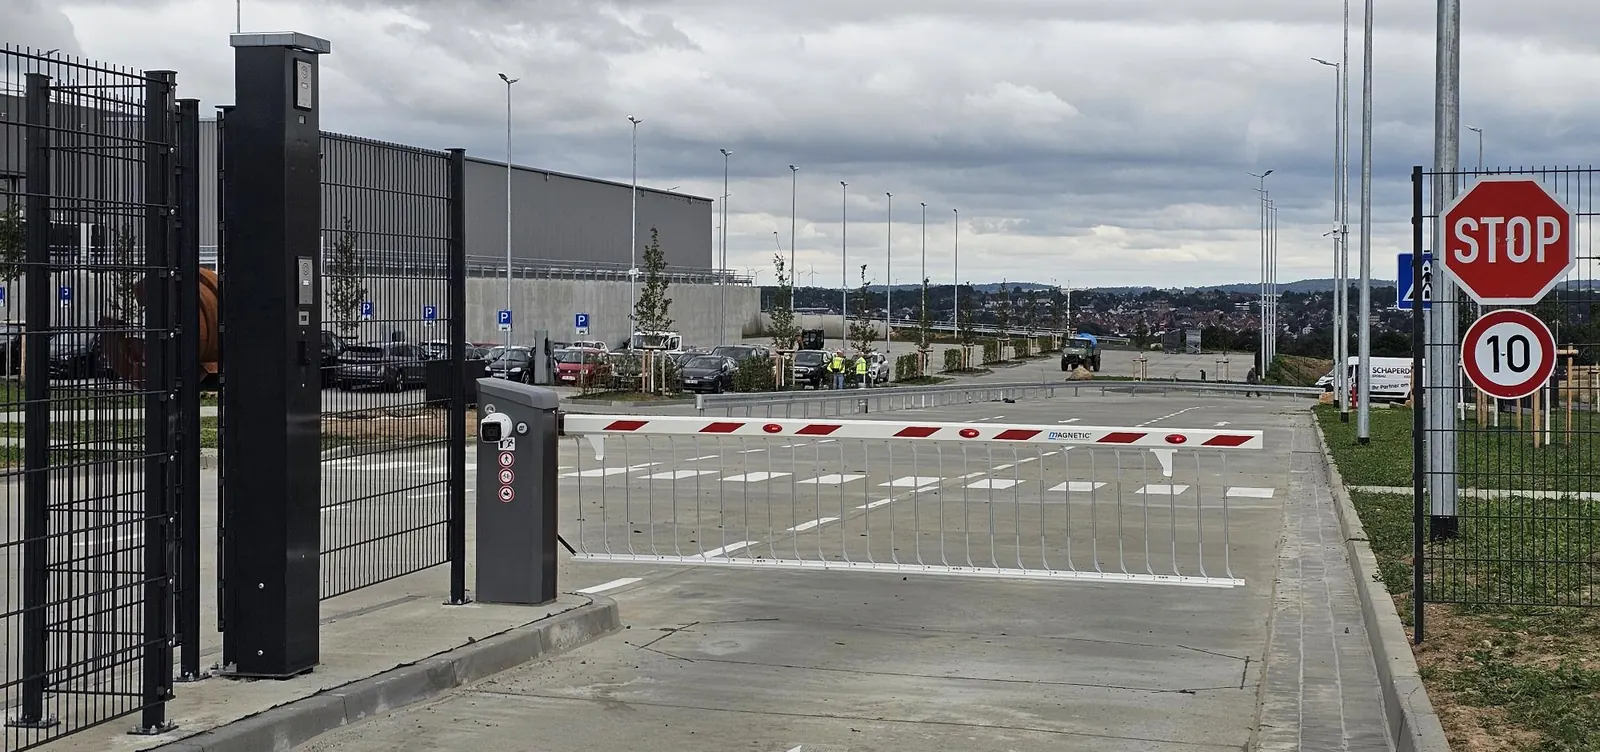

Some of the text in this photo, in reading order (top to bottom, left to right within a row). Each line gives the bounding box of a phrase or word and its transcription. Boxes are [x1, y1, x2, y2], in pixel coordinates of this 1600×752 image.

[1454, 215, 1561, 264] STOP
[501, 312, 509, 323] P
[578, 315, 586, 326] P
[1486, 334, 1531, 374] 10
[1372, 366, 1411, 375] SCHAPERD
